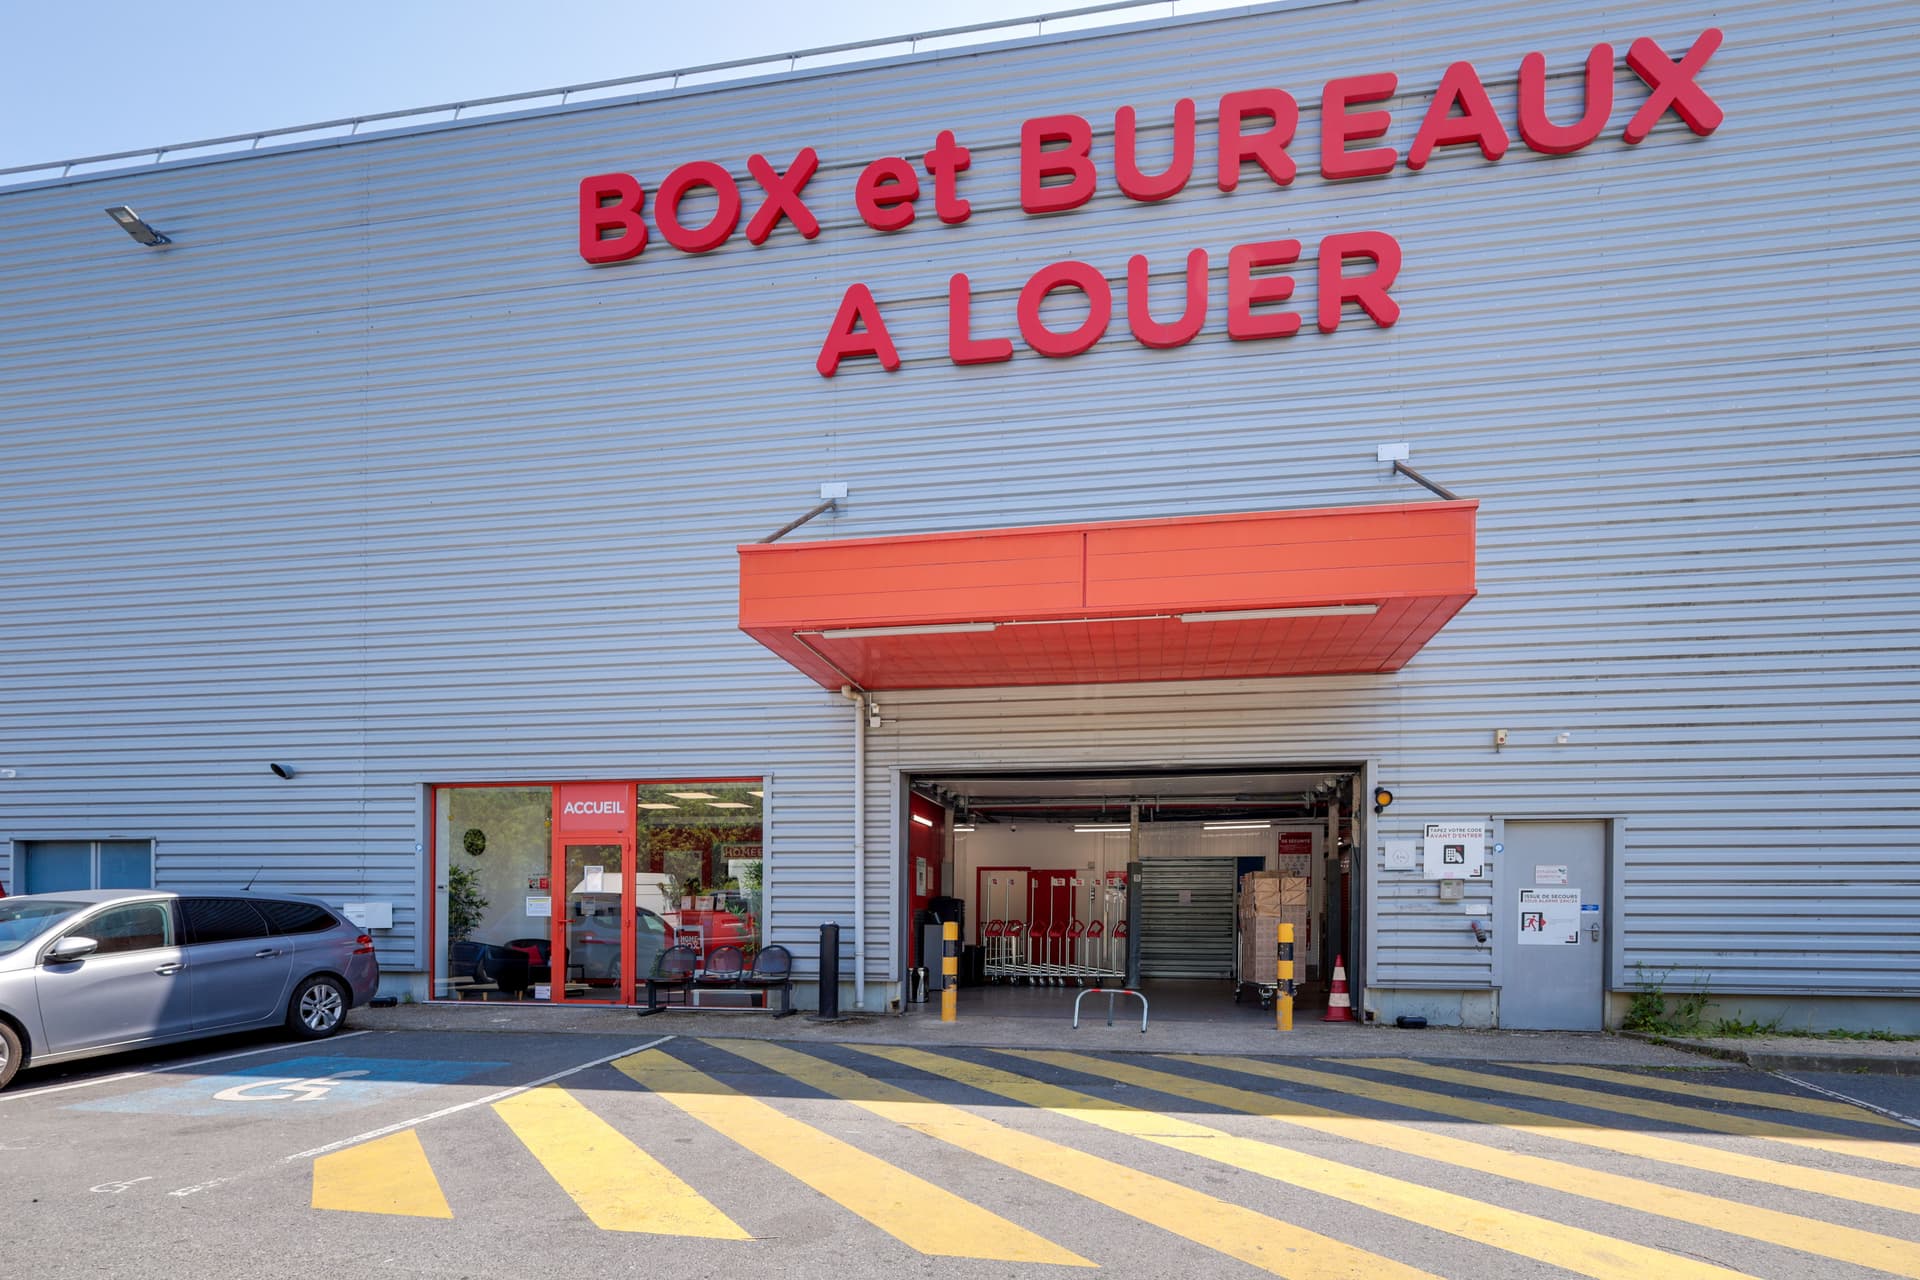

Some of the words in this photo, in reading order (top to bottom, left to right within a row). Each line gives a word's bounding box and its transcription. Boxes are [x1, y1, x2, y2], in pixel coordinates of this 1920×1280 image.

[579, 147, 820, 264] BOX
[855, 131, 971, 231] et
[1020, 27, 1724, 214] BUREAUX
[816, 283, 901, 378] A
[949, 230, 1402, 366] LOUER
[564, 801, 625, 814] ACCUEIL
